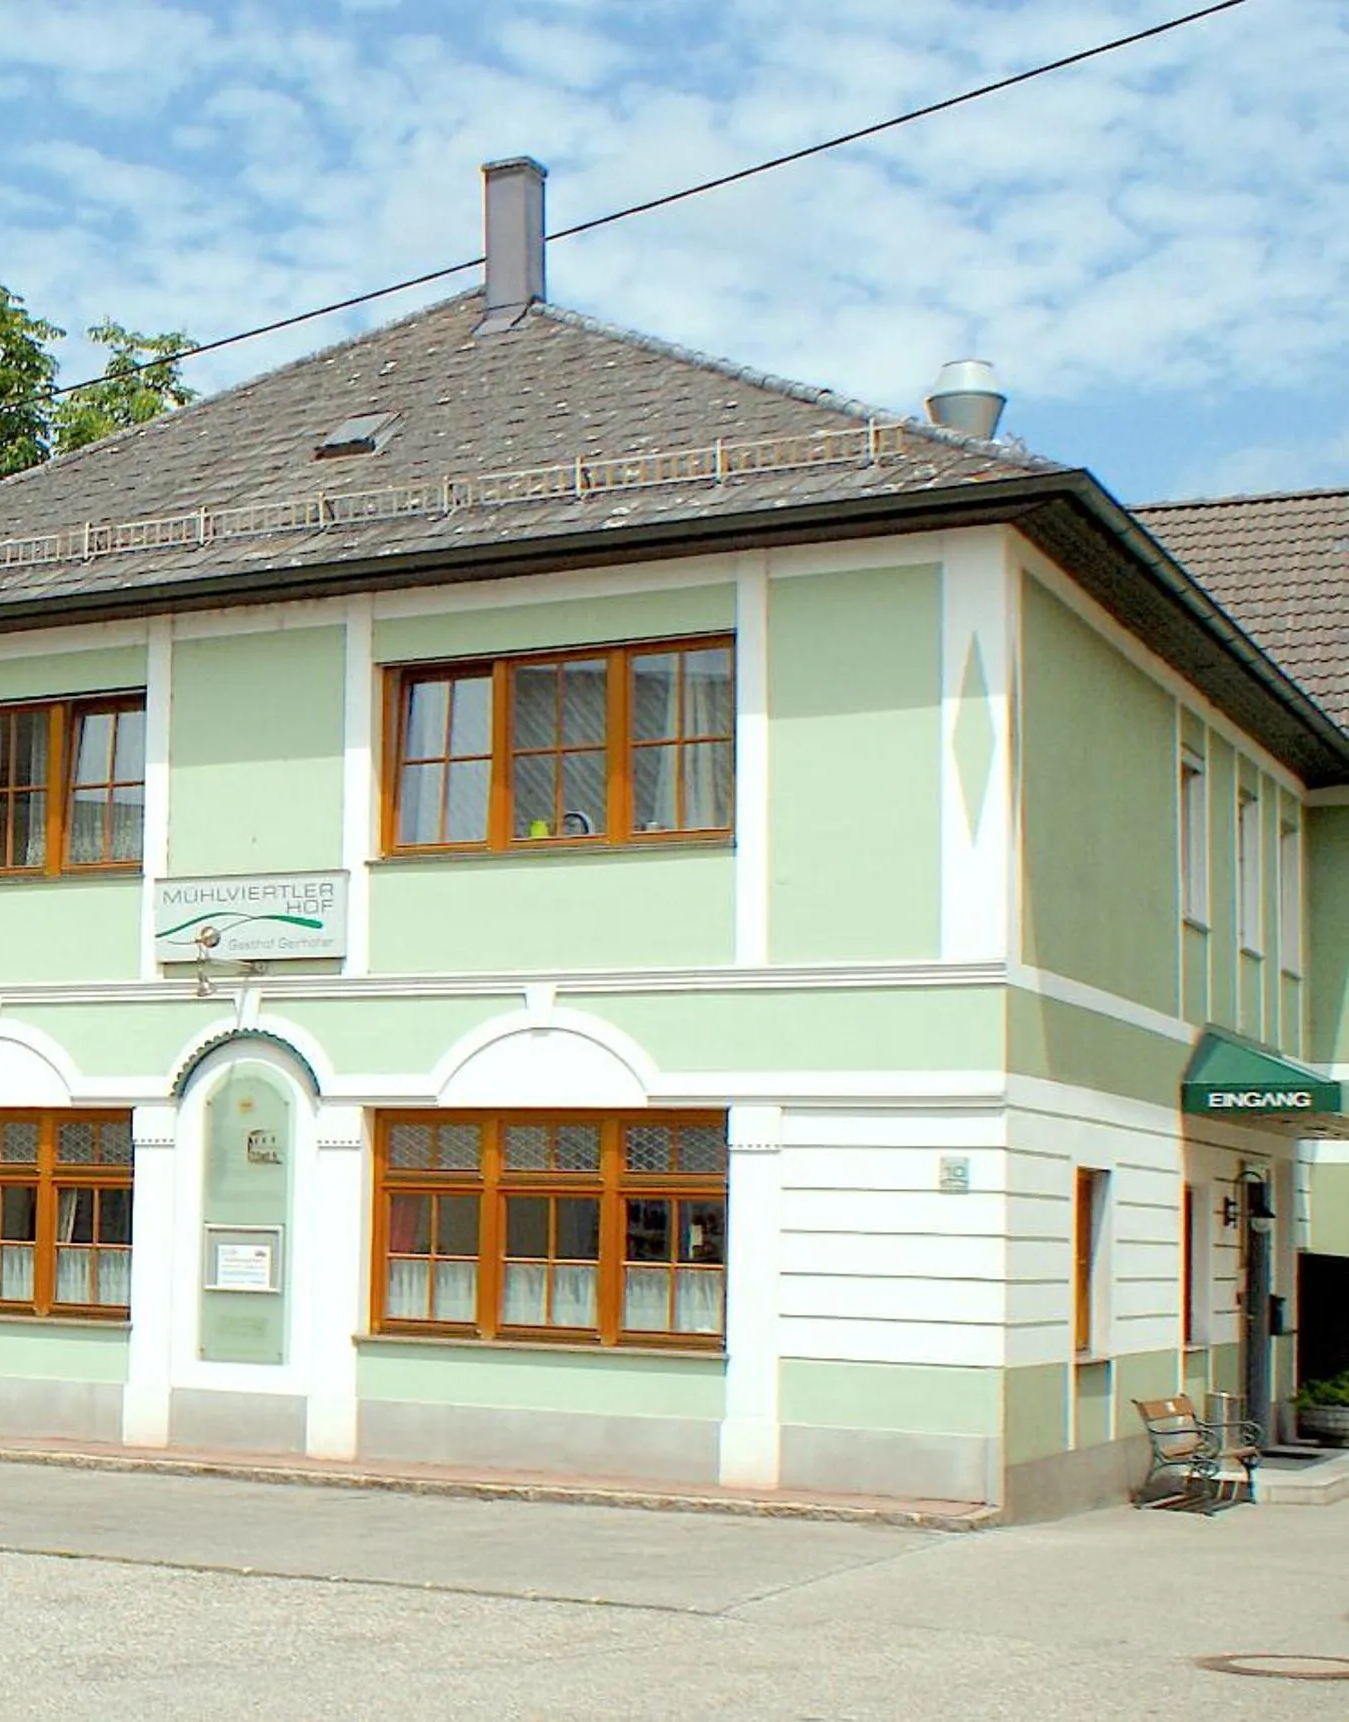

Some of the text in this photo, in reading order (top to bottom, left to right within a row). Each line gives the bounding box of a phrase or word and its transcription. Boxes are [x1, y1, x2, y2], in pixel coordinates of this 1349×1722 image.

[162, 883, 334, 904] MÜHLVIERTLER
[286, 899, 334, 914] HOF
[1208, 1091, 1312, 1107] EINGANG
